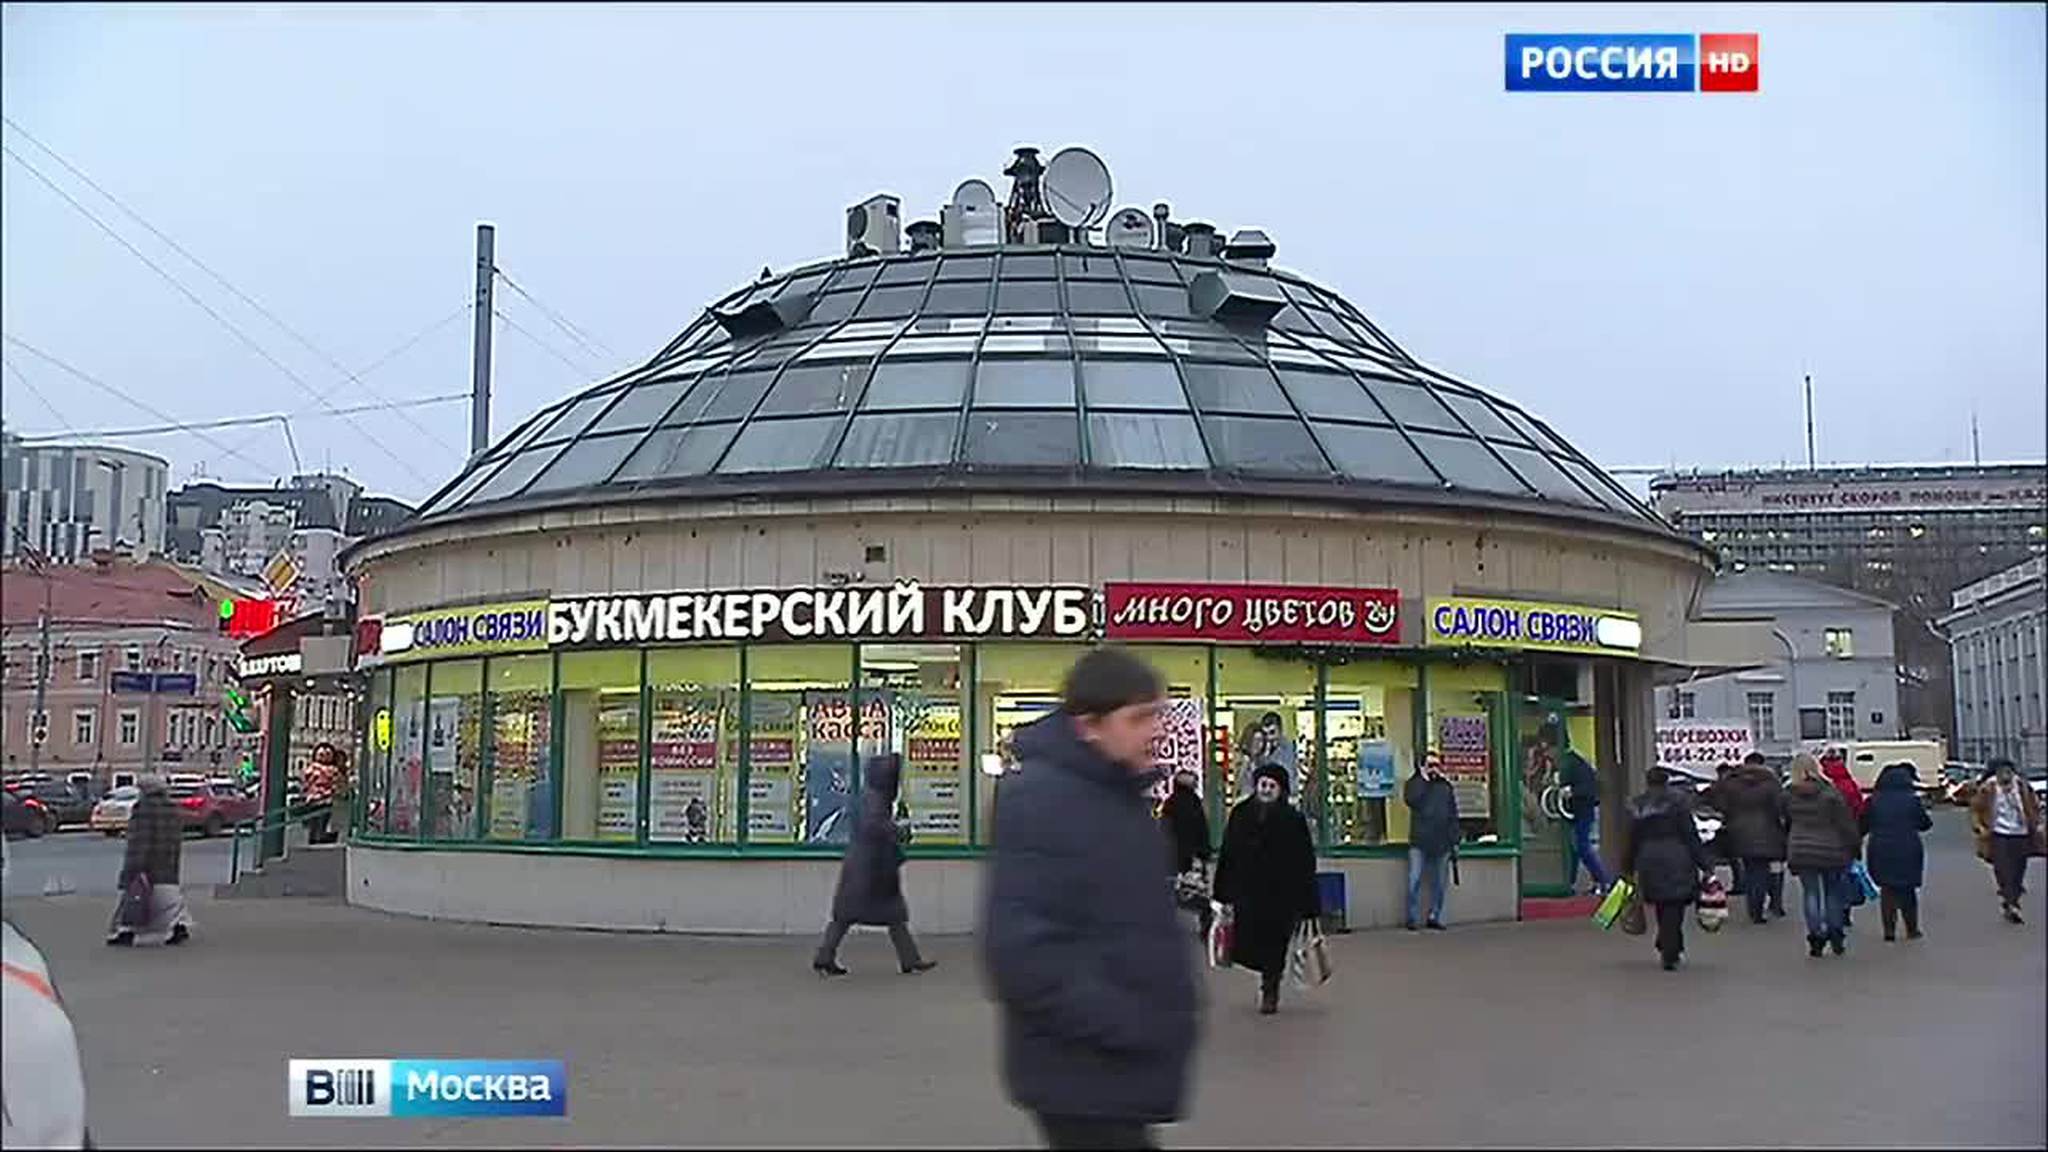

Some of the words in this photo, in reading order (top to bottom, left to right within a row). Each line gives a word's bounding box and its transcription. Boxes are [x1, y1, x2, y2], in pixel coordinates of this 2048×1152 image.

[412, 615, 468, 647] САЛОН
[473, 610, 543, 642] СВЯЗИ
[548, 580, 922, 643] БУКМЕКЕРСКИЙ
[943, 588, 1087, 635] КЛУБ
[1434, 606, 1521, 638] САЛОН
[1527, 611, 1595, 643] СВЯЗИ
